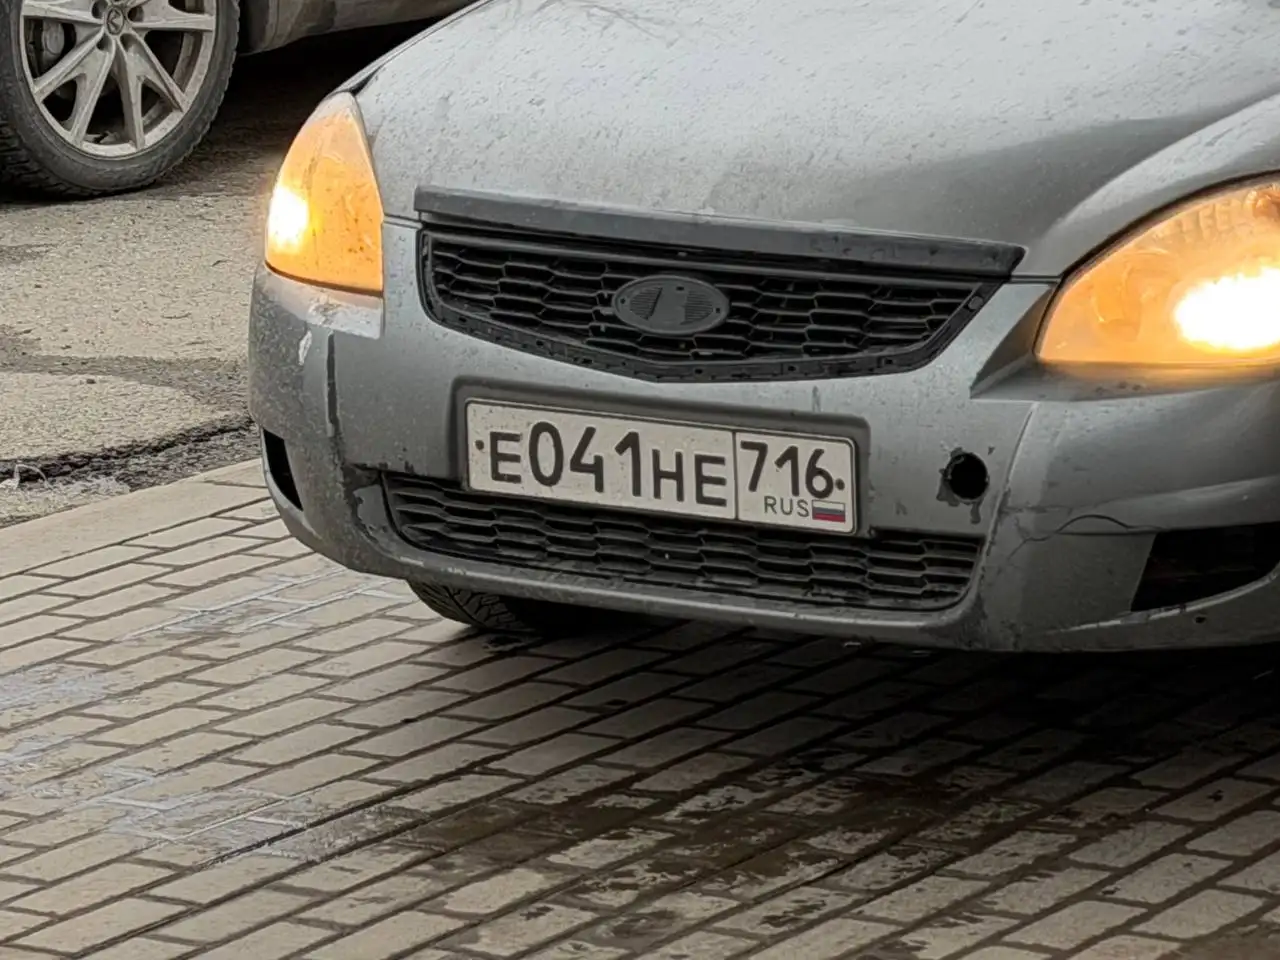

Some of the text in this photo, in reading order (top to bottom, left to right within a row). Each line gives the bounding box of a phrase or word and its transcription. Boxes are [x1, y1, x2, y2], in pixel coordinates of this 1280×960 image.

[490, 421, 834, 507] E041HE 716
[764, 495, 809, 517] RUS
